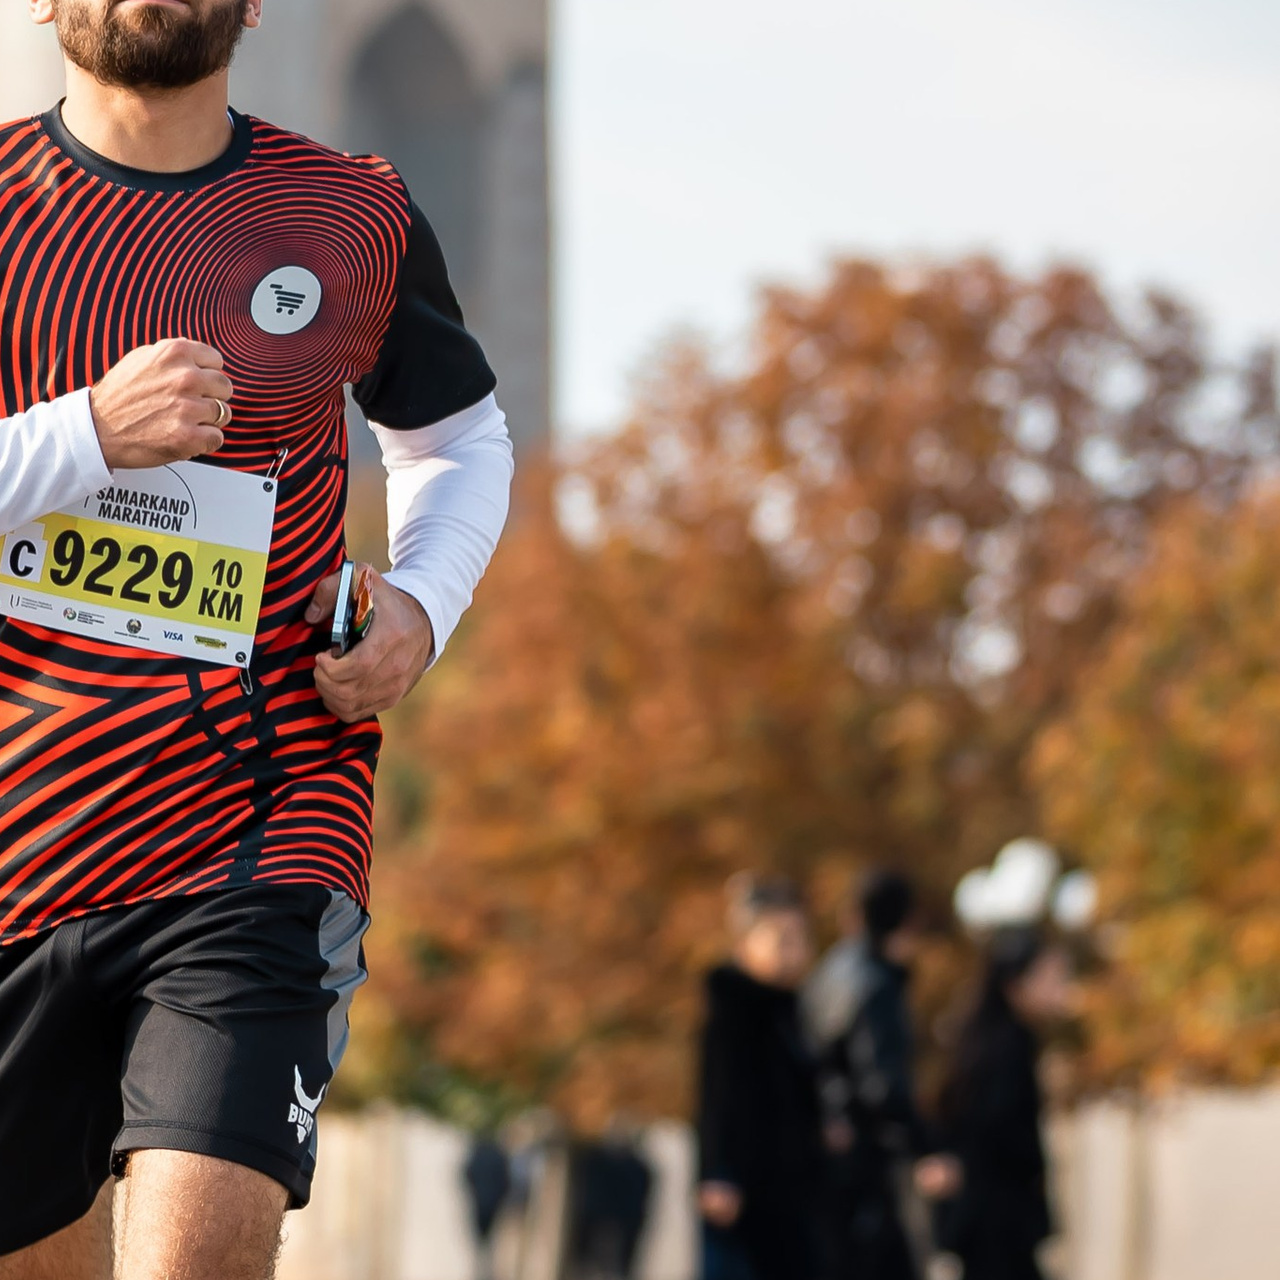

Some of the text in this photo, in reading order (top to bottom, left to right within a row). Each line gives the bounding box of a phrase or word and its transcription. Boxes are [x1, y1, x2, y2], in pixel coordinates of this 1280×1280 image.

[96, 486, 190, 516] SAMARKAND
[98, 502, 183, 532] MARATHON
[9, 529, 194, 609] C 9229
[211, 558, 243, 589] 10
[198, 586, 244, 623] KM
[163, 630, 184, 642] VISA
